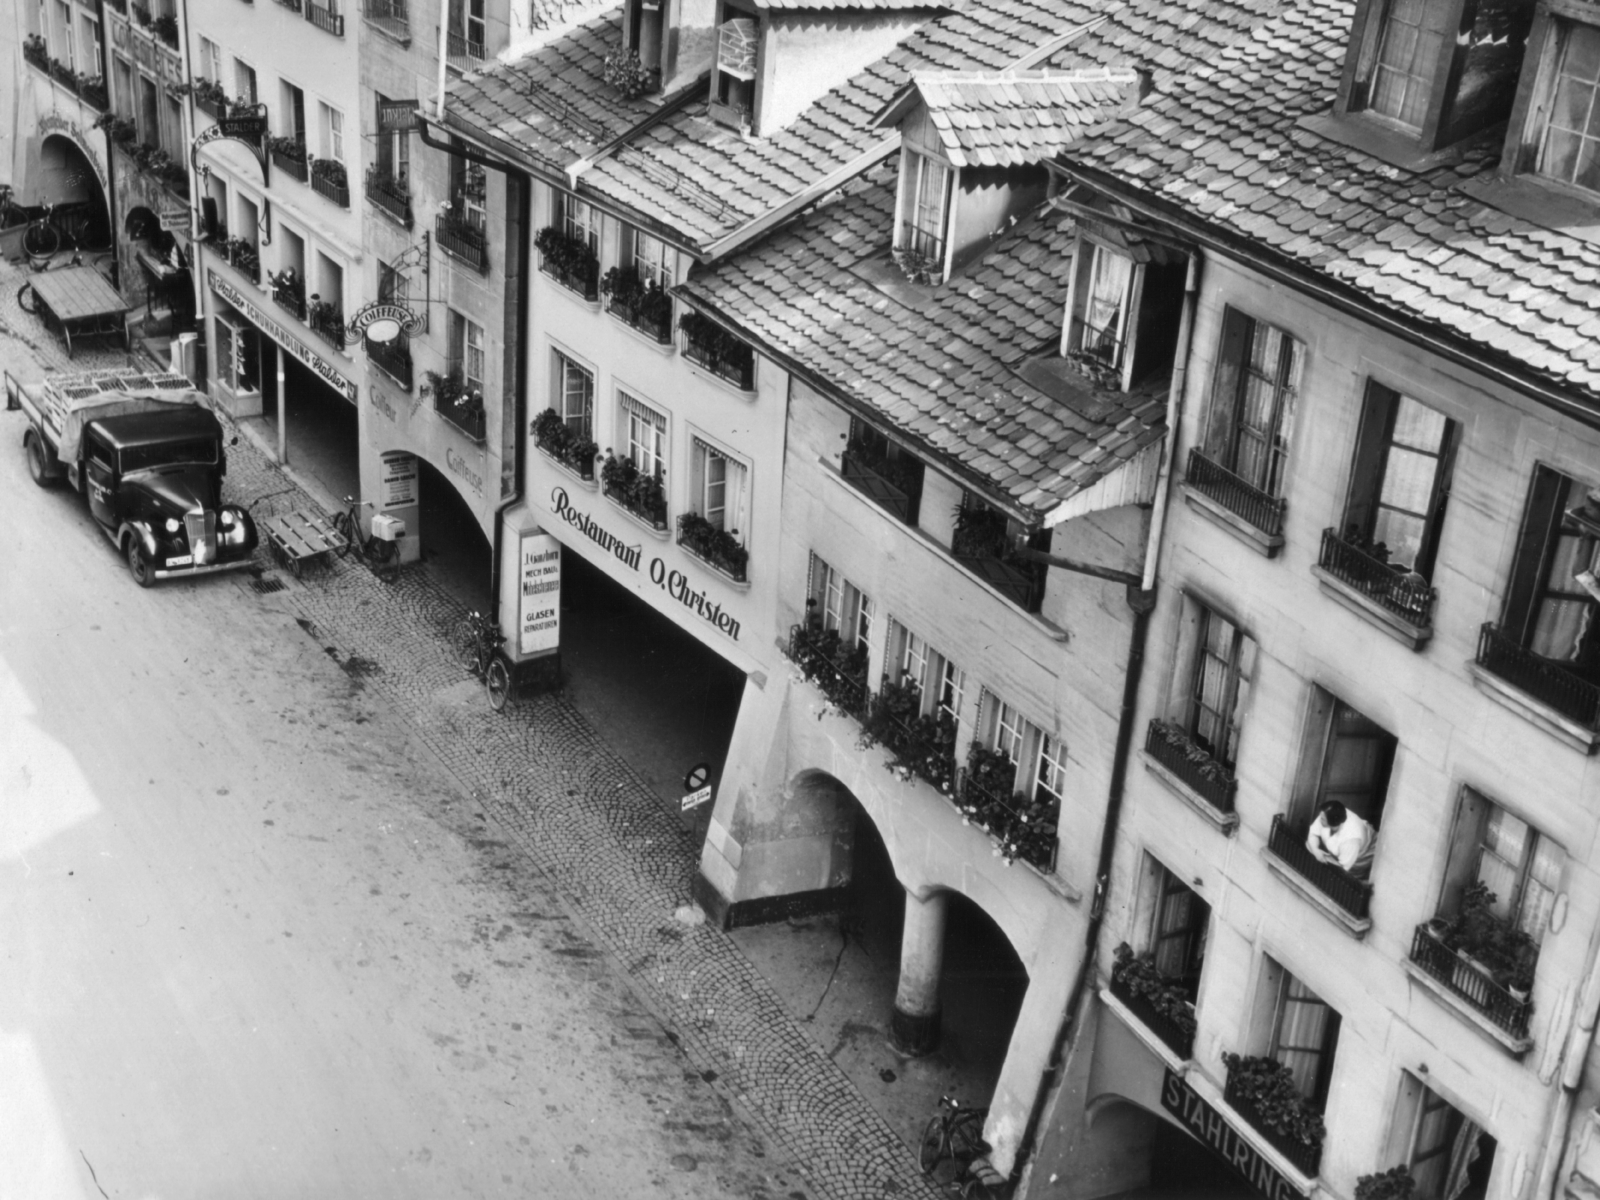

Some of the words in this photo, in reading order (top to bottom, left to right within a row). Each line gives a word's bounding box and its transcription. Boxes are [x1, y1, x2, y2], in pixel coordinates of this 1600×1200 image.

[225, 122, 261, 133] STALDER
[216, 278, 245, 308] Stalder
[246, 303, 310, 363] SCHUHHANDLUNG
[312, 357, 346, 391] Stalder
[360, 306, 409, 327] COIFFEUSE
[369, 384, 397, 424] Coiffeur
[446, 447, 483, 493] Coiffeuse
[550, 486, 642, 572] Restaurant
[523, 619, 558, 634] REPARATUREN
[526, 608, 555, 622] GLASEN
[1166, 1073, 1292, 1200] STAHLRING
